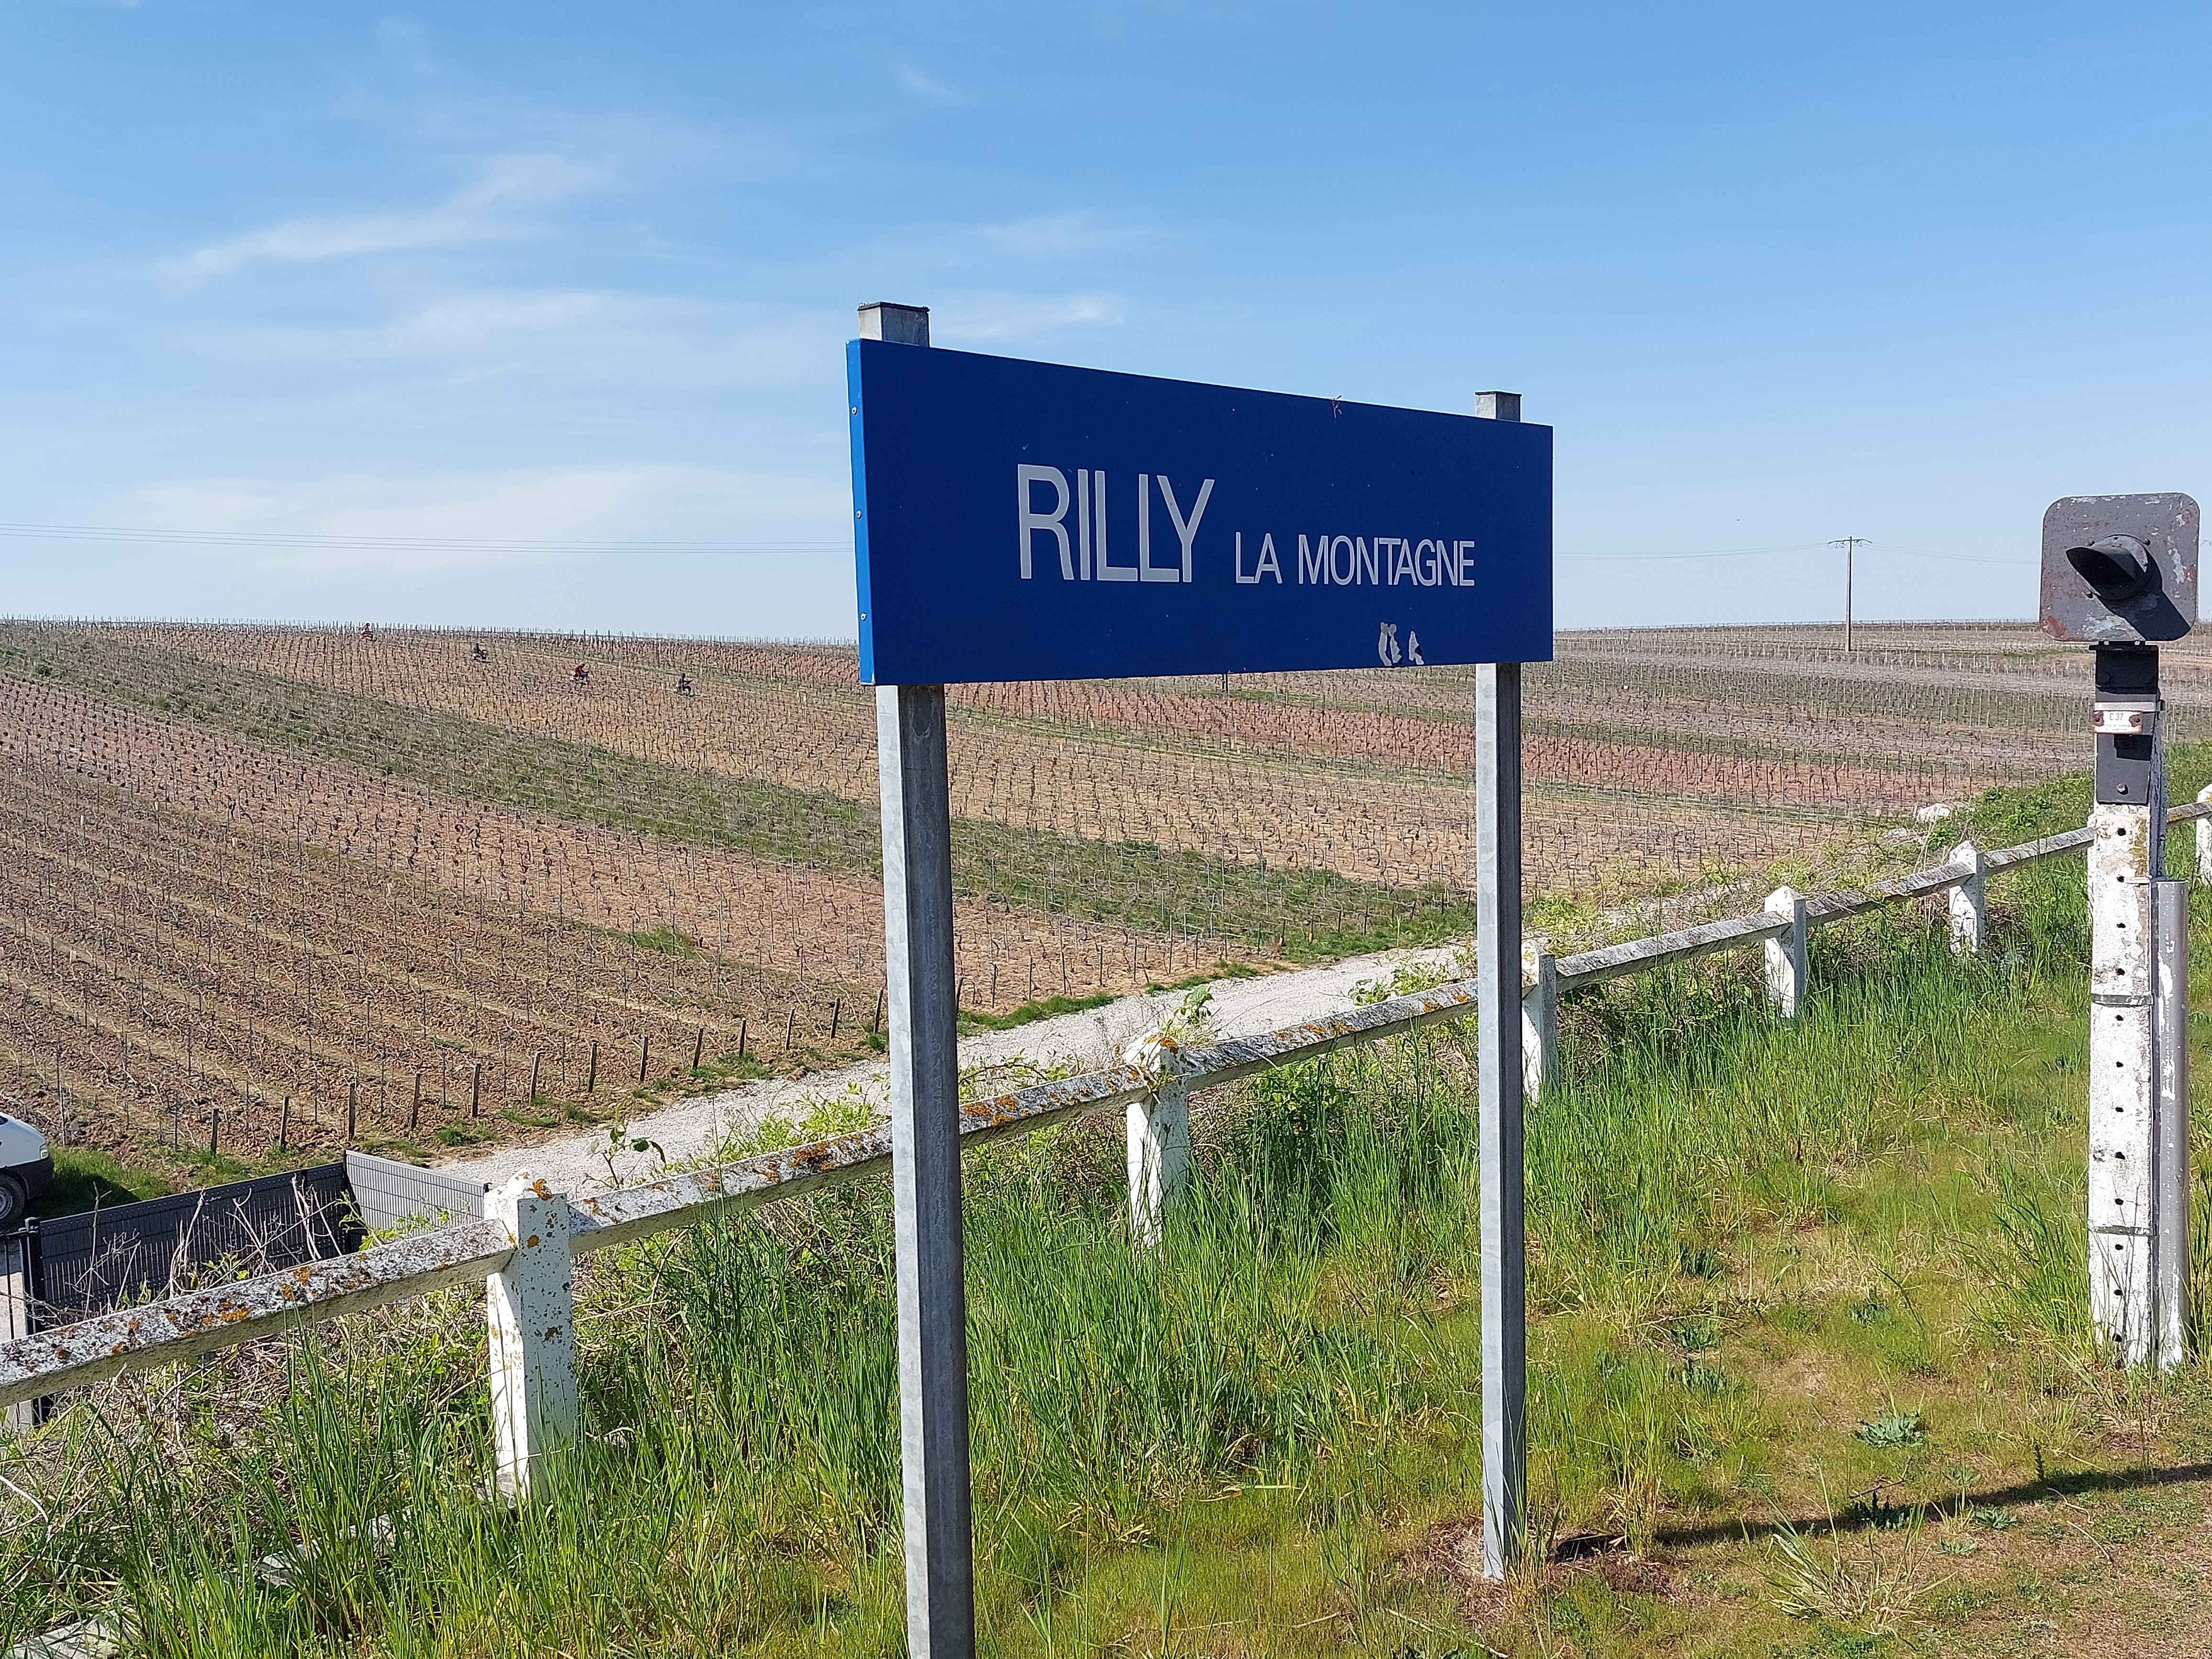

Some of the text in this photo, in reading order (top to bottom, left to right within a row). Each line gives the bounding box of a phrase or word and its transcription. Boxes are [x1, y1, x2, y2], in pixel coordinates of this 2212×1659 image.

[1018, 464, 1475, 586] RILLY LA MONTAGNE
